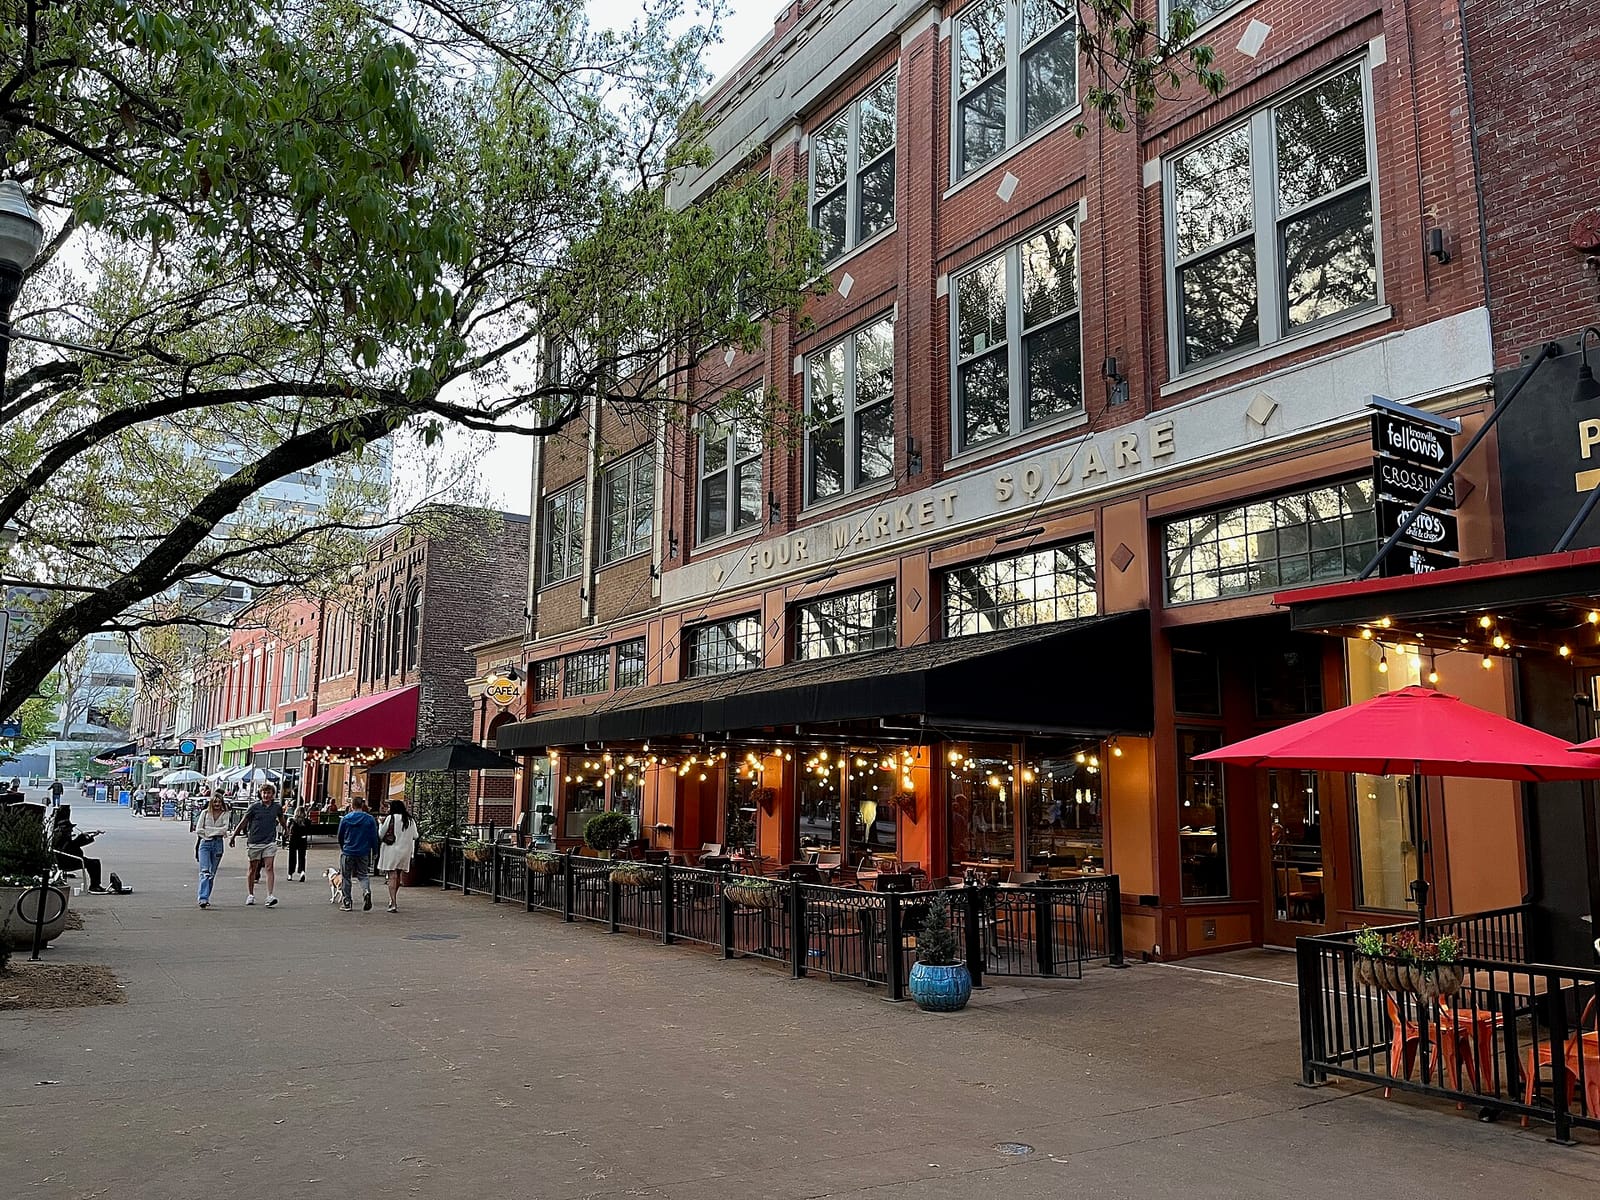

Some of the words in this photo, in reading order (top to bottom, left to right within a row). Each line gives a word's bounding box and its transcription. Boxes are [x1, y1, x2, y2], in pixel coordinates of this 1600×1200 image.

[1387, 422, 1438, 459] fellows
[748, 536, 809, 574] FOUR
[832, 489, 958, 550] MARKET
[995, 419, 1175, 502] SQUARE
[1401, 510, 1440, 532] Ptro's
